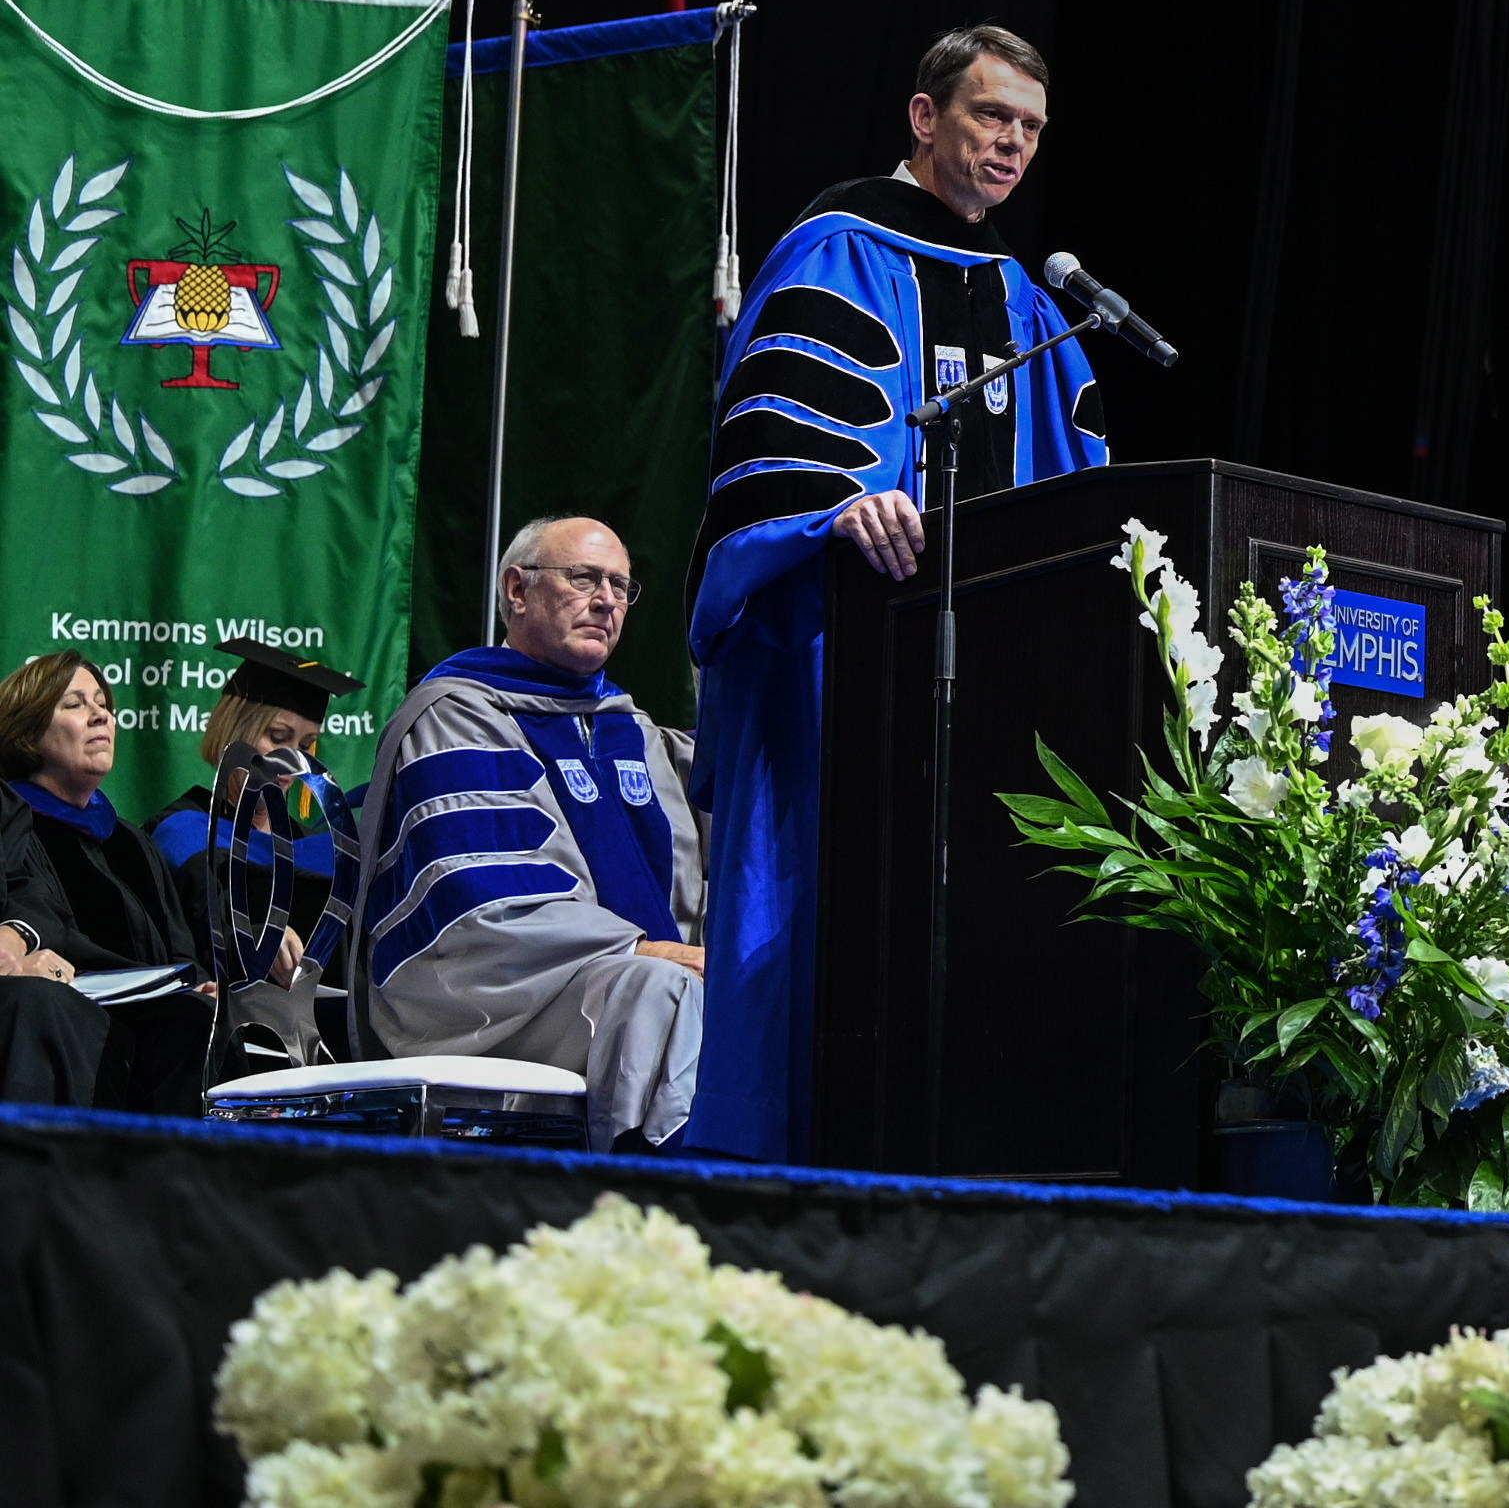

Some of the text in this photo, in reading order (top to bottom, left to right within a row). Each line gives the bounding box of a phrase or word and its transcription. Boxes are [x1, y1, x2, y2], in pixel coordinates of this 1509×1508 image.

[52, 612, 324, 648] Kemmons Wilson
[1401, 618, 1420, 637] OF
[142, 659, 174, 686] of
